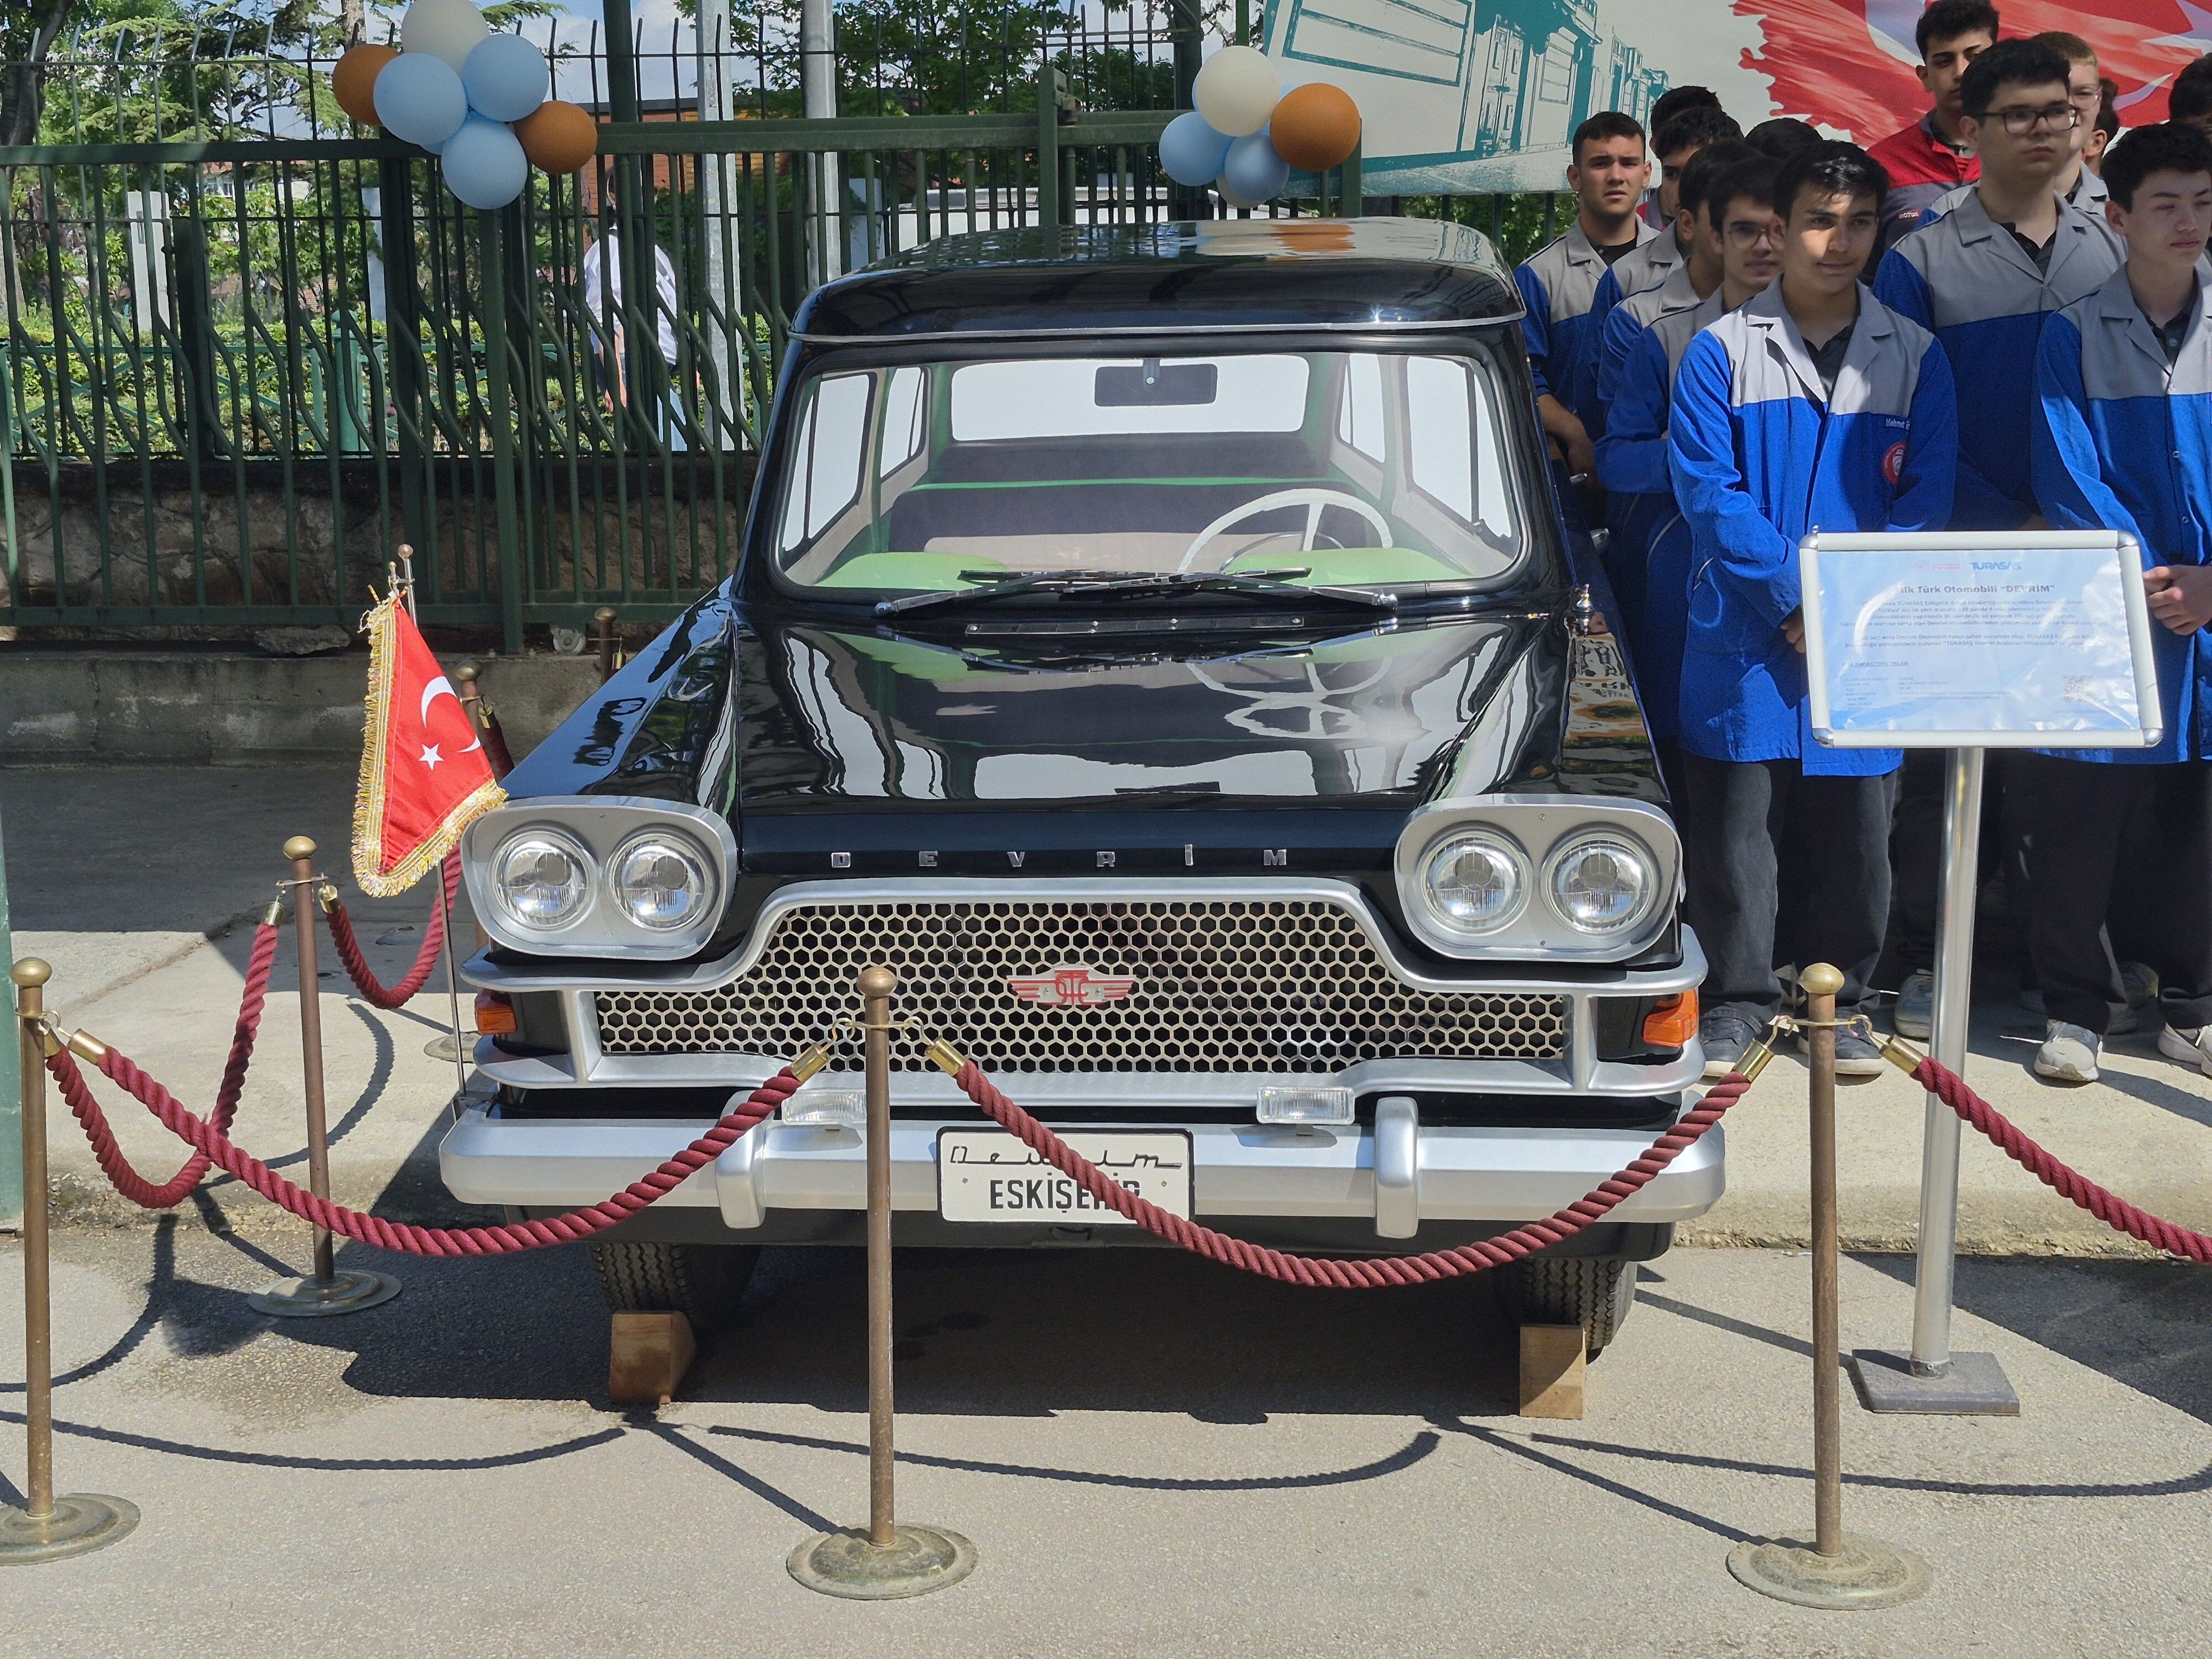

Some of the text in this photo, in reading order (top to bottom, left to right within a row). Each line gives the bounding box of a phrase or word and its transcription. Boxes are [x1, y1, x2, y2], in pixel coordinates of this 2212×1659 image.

[1917, 585, 1940, 593] Türk
[1944, 585, 1997, 593] Otomobili
[831, 844, 1287, 868] DEVRİM
